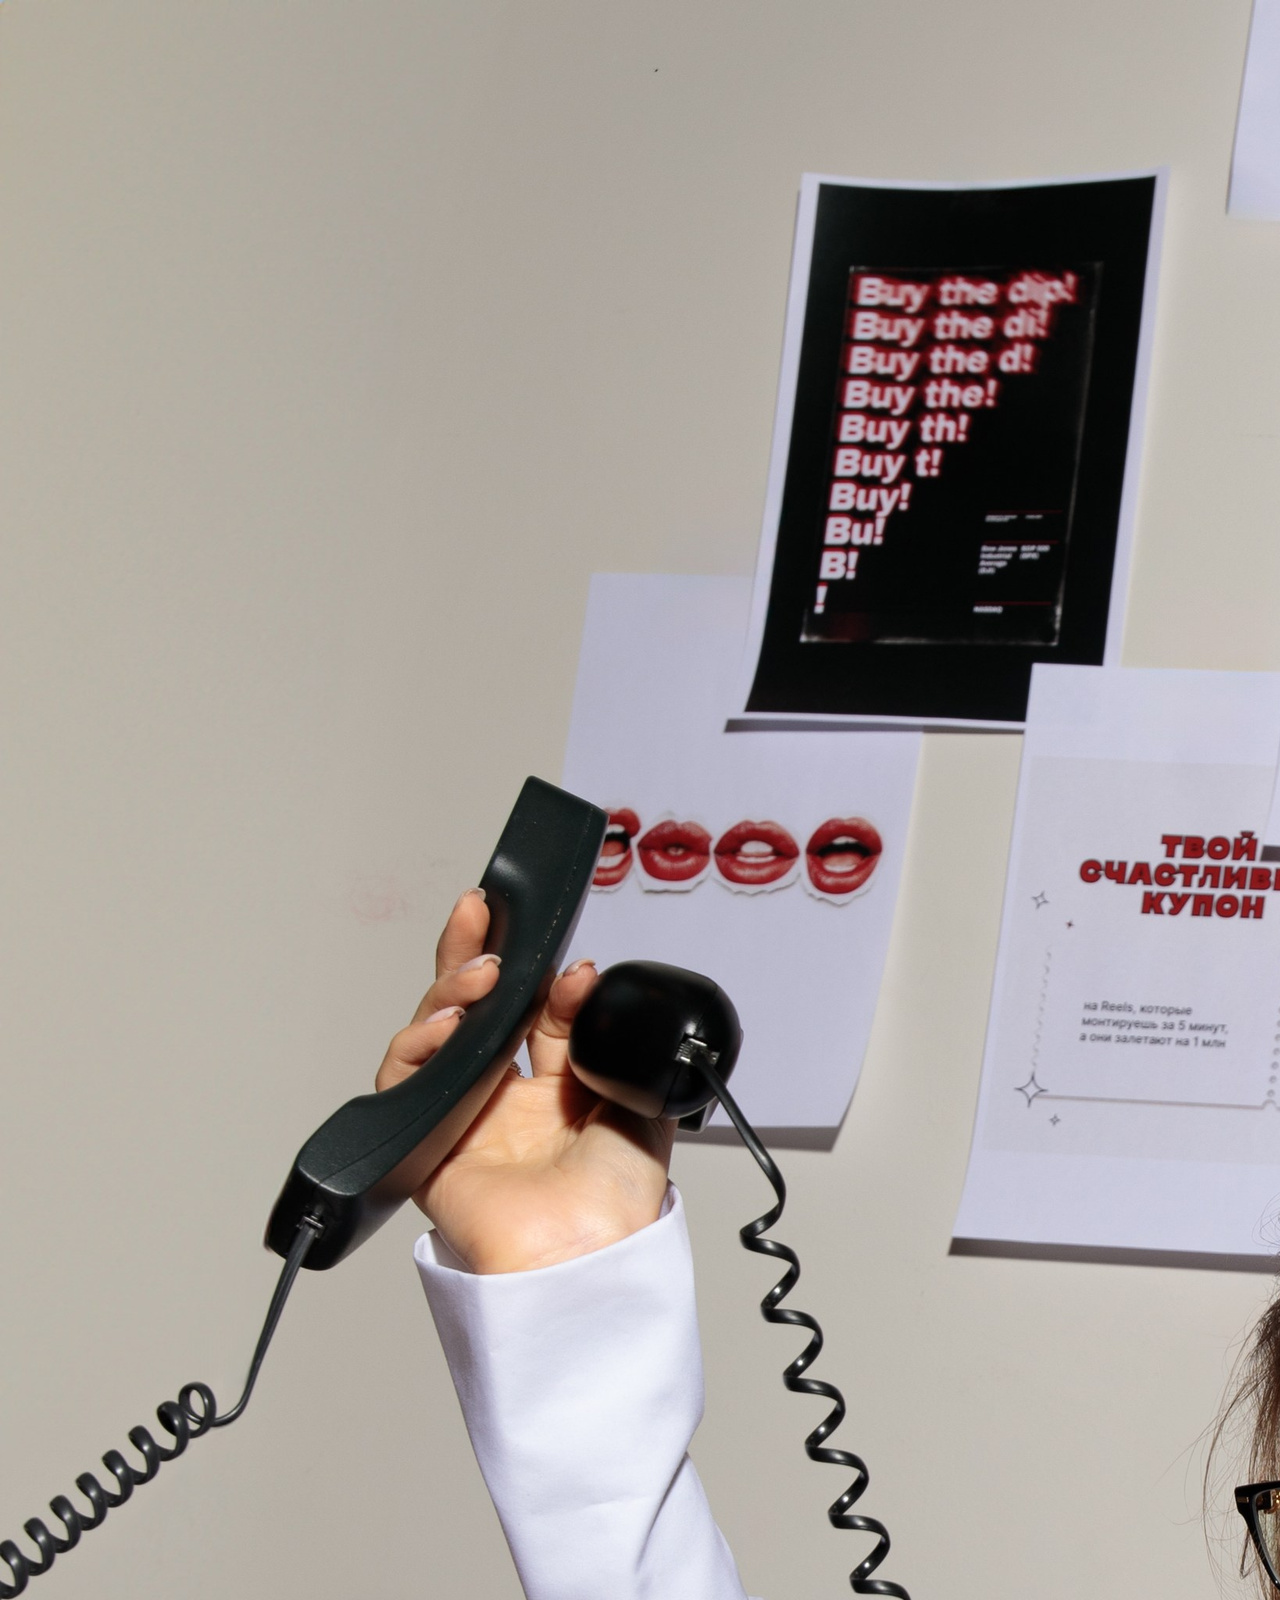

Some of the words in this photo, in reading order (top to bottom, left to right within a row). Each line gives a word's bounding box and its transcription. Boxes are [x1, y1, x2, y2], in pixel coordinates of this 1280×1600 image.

[857, 277, 929, 313] Buy
[940, 277, 998, 305] the
[853, 312, 924, 347] Buy
[934, 311, 994, 339] the
[848, 346, 919, 381] Buy
[930, 346, 989, 373] the
[999, 344, 1034, 372] d!
[843, 380, 915, 416] Buy
[925, 379, 997, 407] the!
[839, 414, 910, 450] Buy
[920, 413, 969, 443] th!
[834, 448, 906, 484] Buy
[915, 448, 942, 477] t!
[829, 482, 912, 517] Buy!
[824, 516, 886, 545] Bu!
[819, 550, 859, 580] B!
[1161, 830, 1258, 861] ТВОЙ
[1141, 891, 1266, 919] КУПОН
[1083, 1002, 1098, 1011] на
[1101, 1001, 1136, 1014] Reels,
[1140, 1005, 1193, 1016] которые
[1079, 1033, 1087, 1041] а
[1089, 1033, 1112, 1042] они
[1115, 1035, 1172, 1046] залетают
[1175, 1038, 1190, 1046] на
[1193, 1037, 1199, 1046] 1
[1202, 1039, 1227, 1048] млн
[1081, 1018, 1158, 1030] монтируешь
[1162, 1022, 1175, 1030] за
[1178, 1020, 1186, 1031] 5
[1189, 1024, 1229, 1034] минут,
